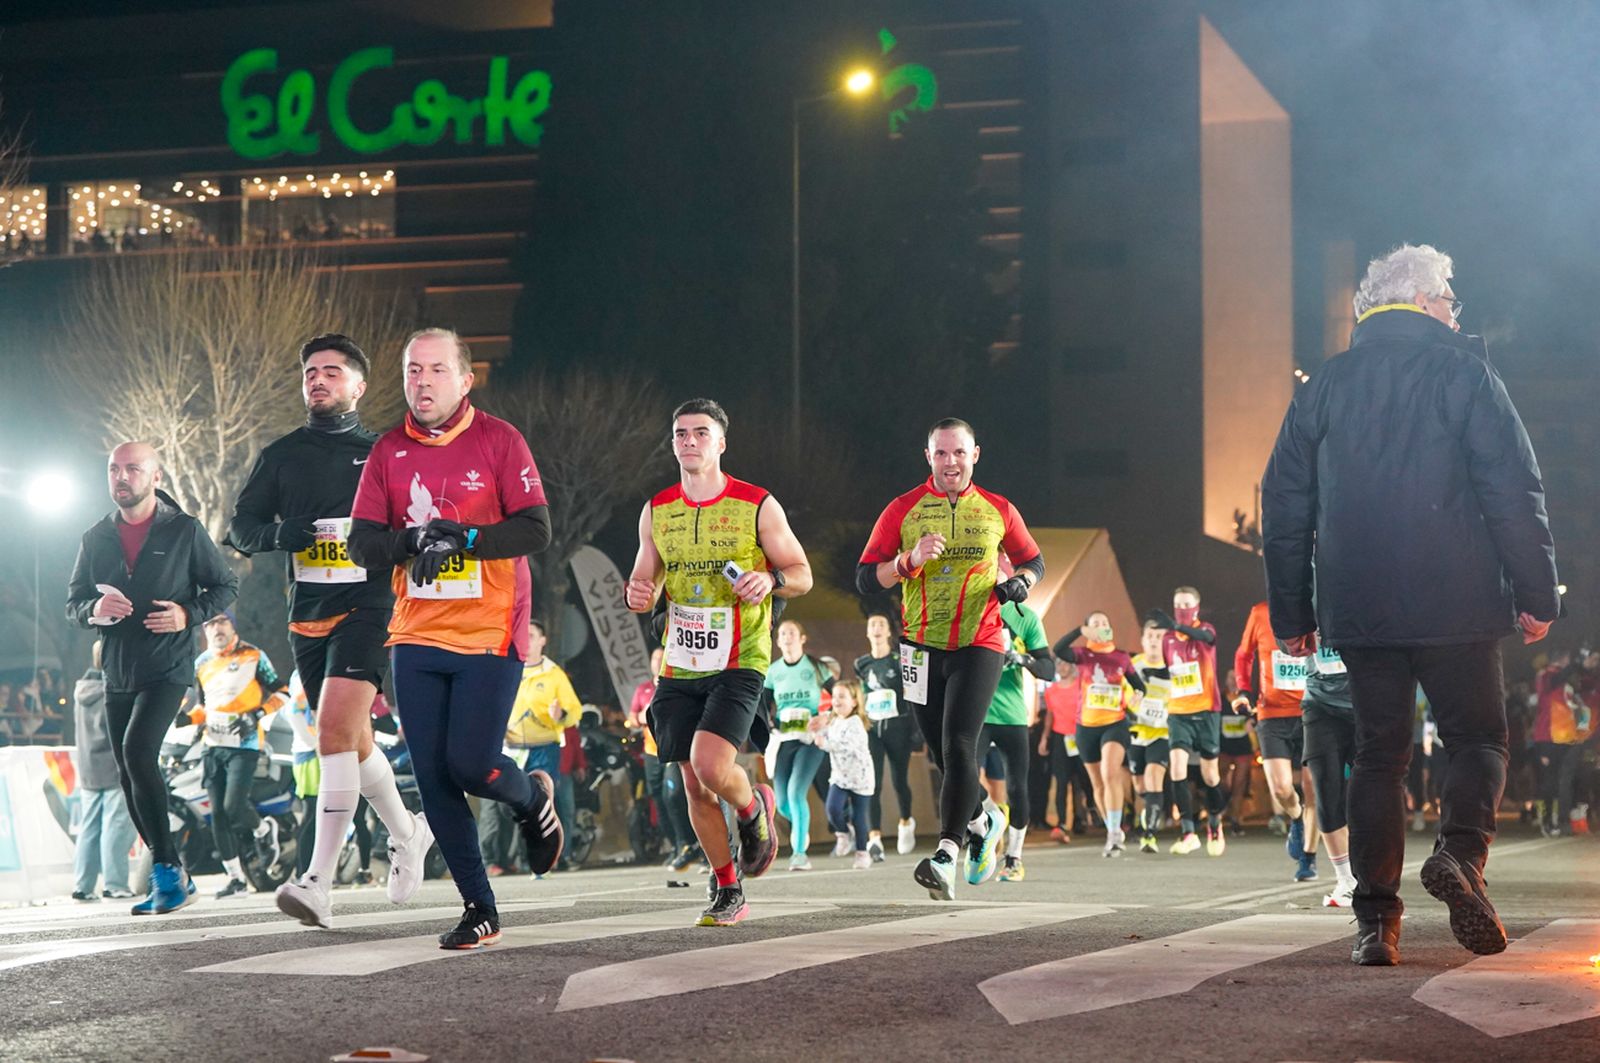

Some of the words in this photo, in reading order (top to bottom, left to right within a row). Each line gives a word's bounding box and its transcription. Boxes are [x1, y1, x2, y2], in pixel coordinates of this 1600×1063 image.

[221, 47, 320, 160] El
[327, 46, 553, 154] Corte
[308, 541, 349, 561] 3183
[684, 559, 731, 571] HYUND
[676, 626, 719, 650] 3956
